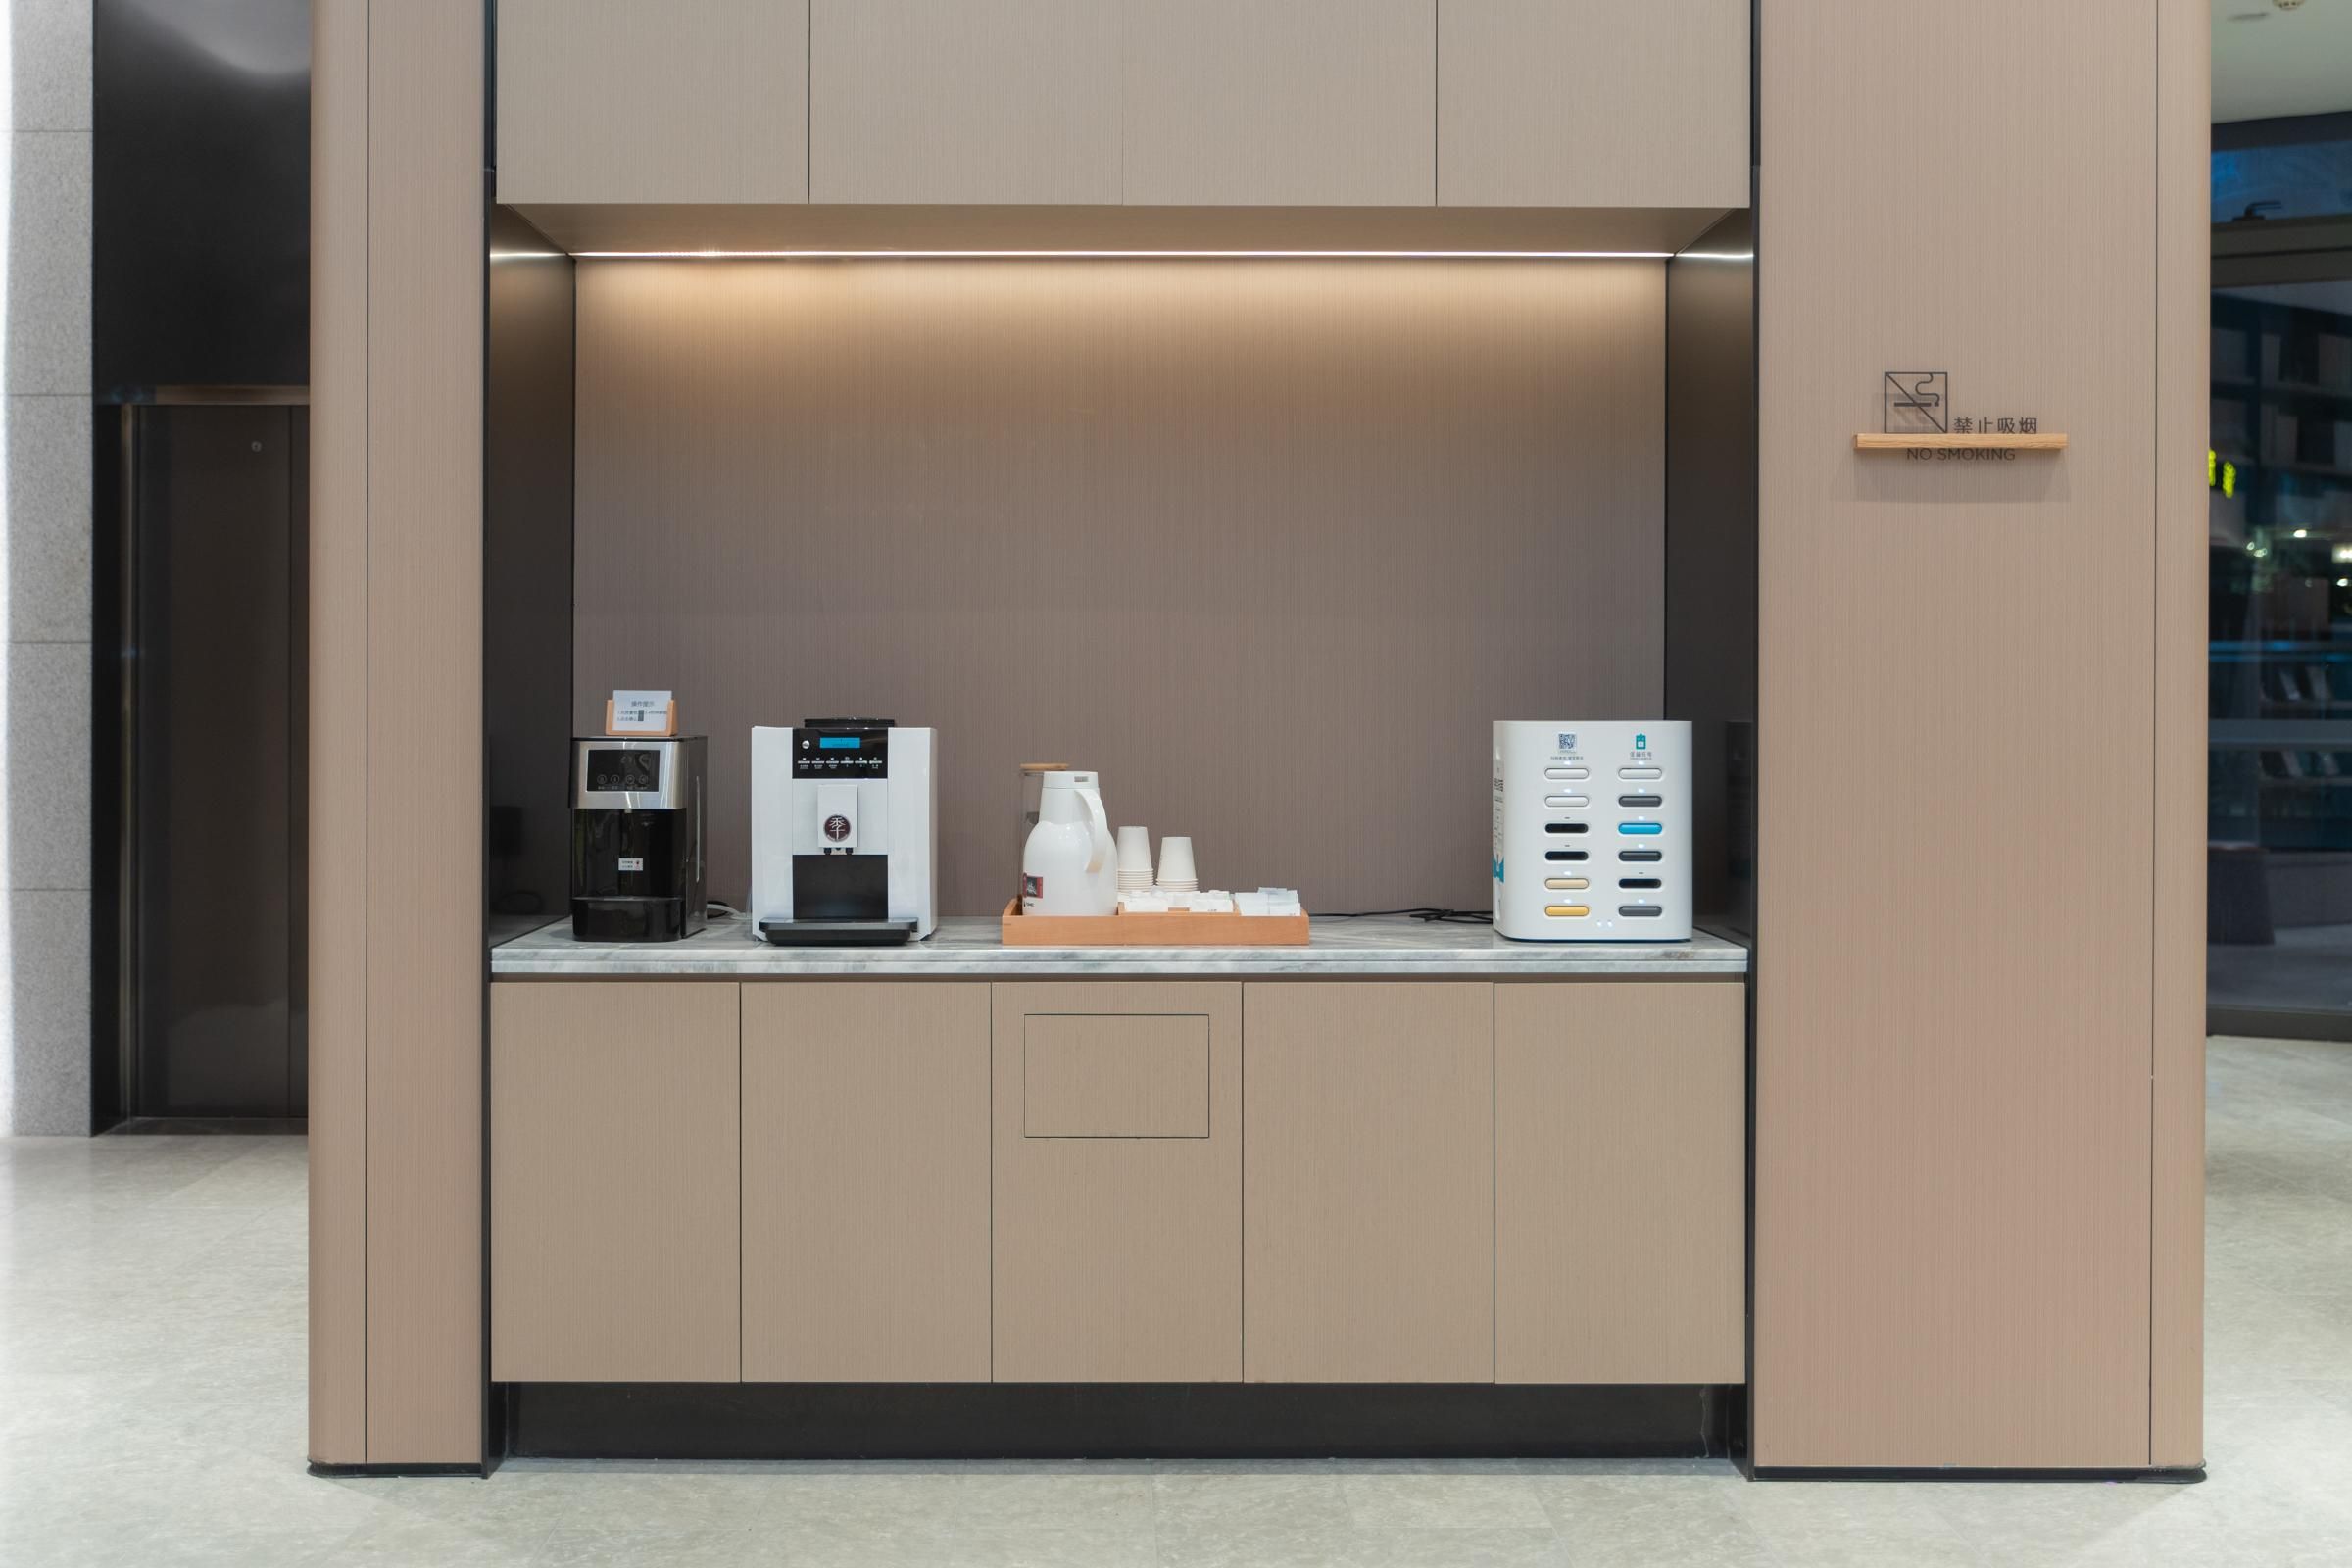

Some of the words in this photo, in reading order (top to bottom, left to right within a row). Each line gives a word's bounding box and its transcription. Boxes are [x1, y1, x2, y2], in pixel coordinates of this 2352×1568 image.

[1953, 416, 2037, 434] 禁止吸烟
[1906, 447, 1933, 461] NO
[1936, 447, 2016, 461] SMOKING
